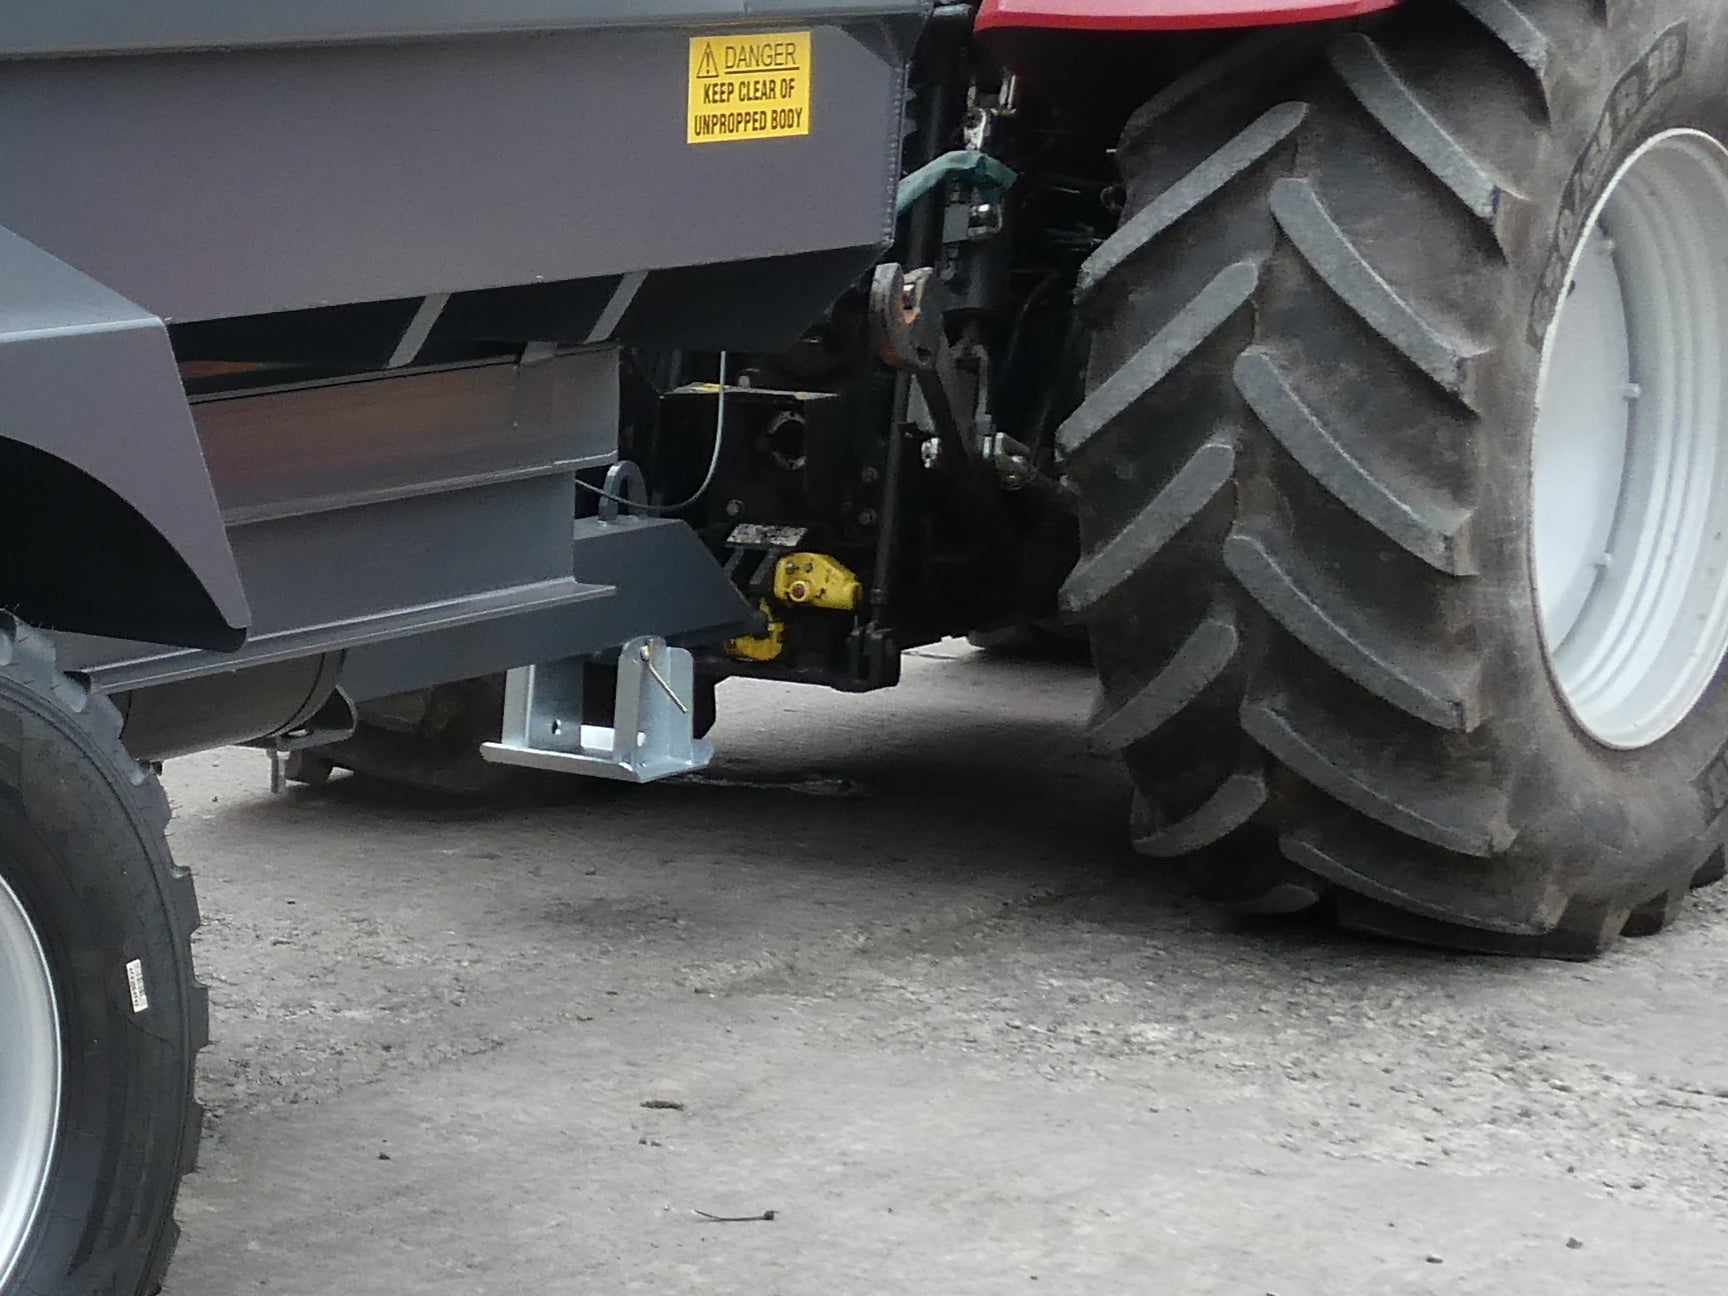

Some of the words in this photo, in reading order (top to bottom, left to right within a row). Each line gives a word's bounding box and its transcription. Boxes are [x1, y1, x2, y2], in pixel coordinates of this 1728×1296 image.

[725, 45, 798, 70] DANGER
[703, 82, 735, 105] KEEP
[739, 80, 776, 102] CLEAR
[780, 78, 795, 99] OF
[693, 111, 767, 137] UNPROPPED
[770, 107, 803, 131] BODY
